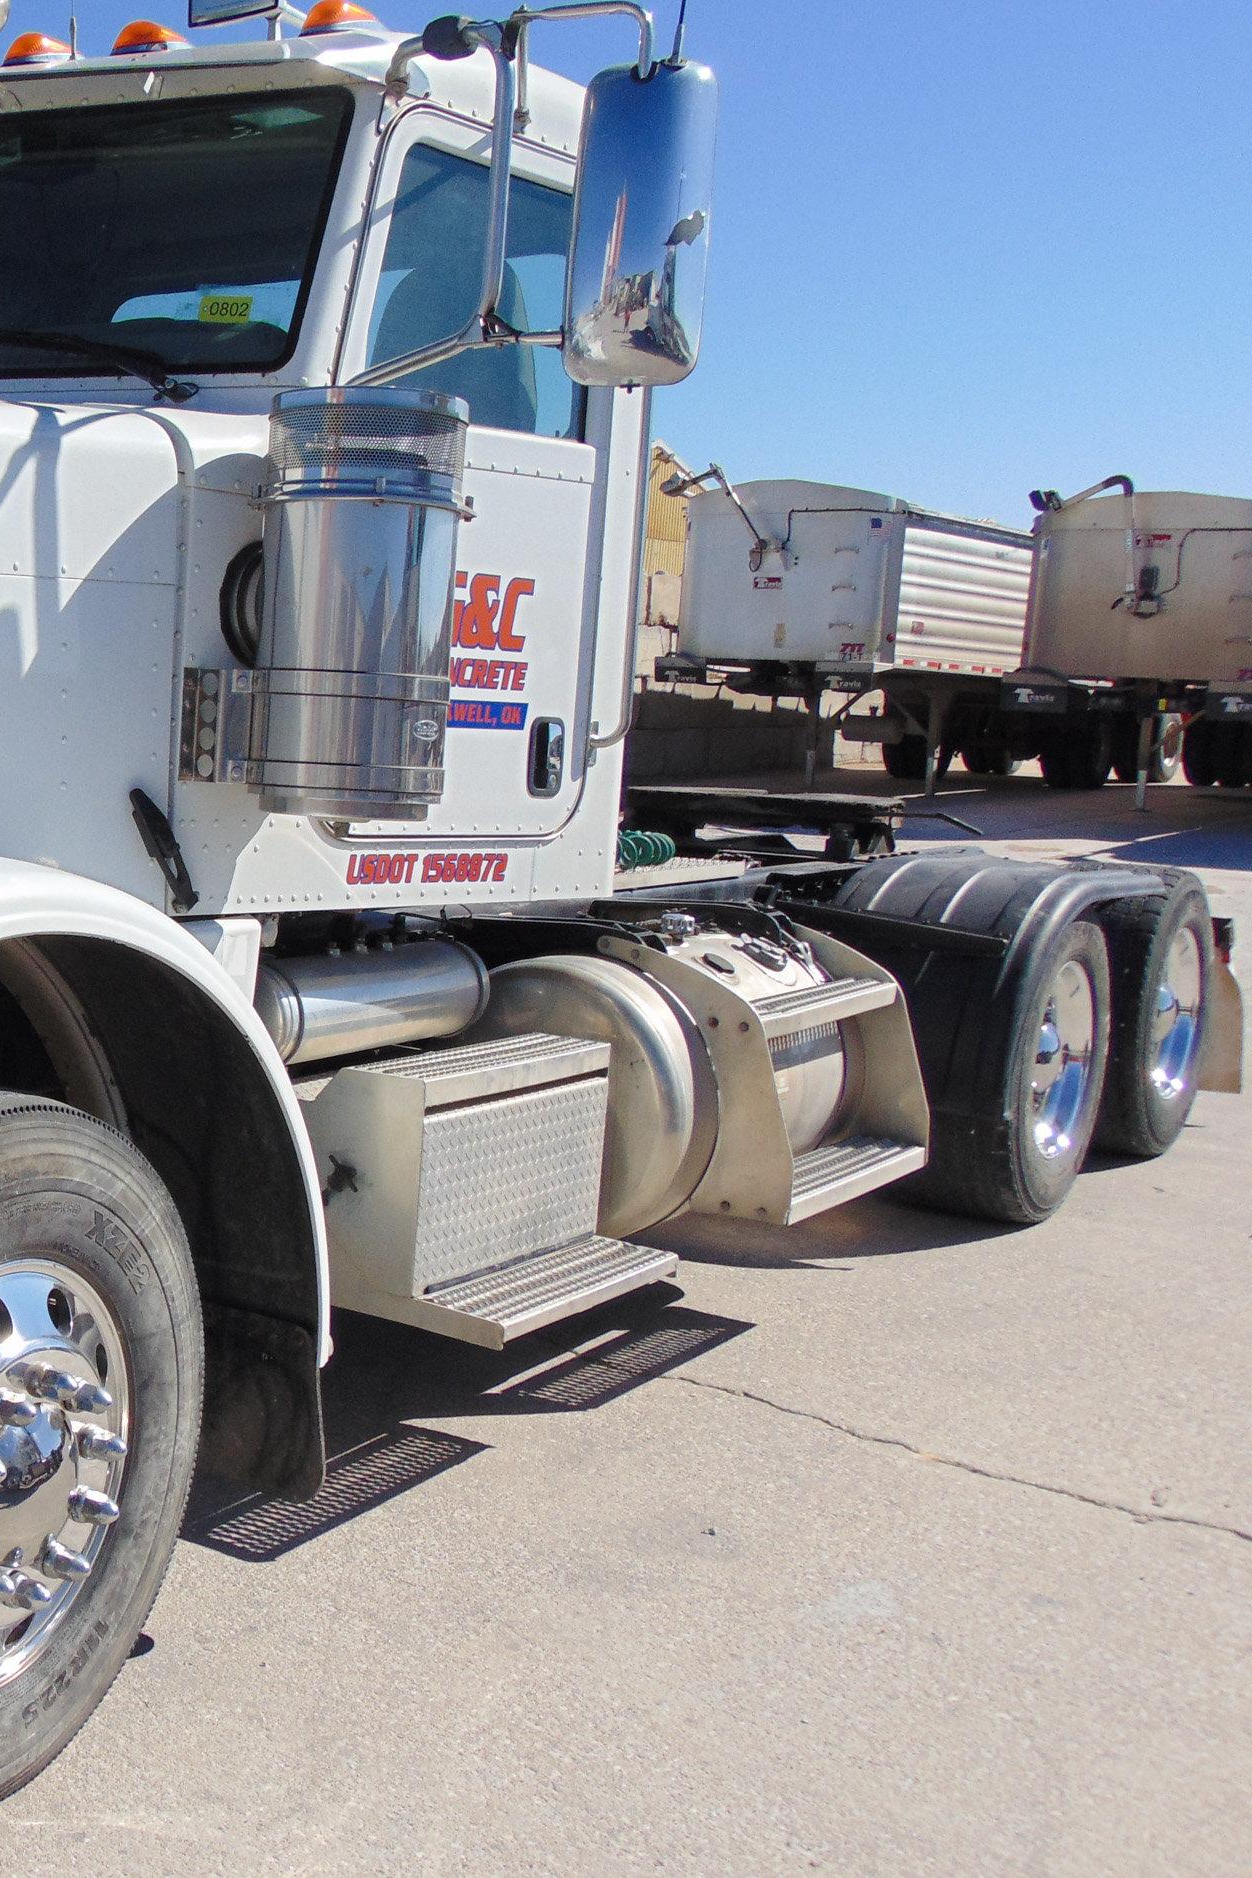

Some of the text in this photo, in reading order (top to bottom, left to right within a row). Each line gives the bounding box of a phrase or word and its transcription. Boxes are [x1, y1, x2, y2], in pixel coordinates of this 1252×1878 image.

[209, 301, 249, 317] 0802
[449, 656, 529, 691] NCRETE
[346, 853, 508, 885] USDOT 1568872
[84, 1208, 151, 1297] XZE2
